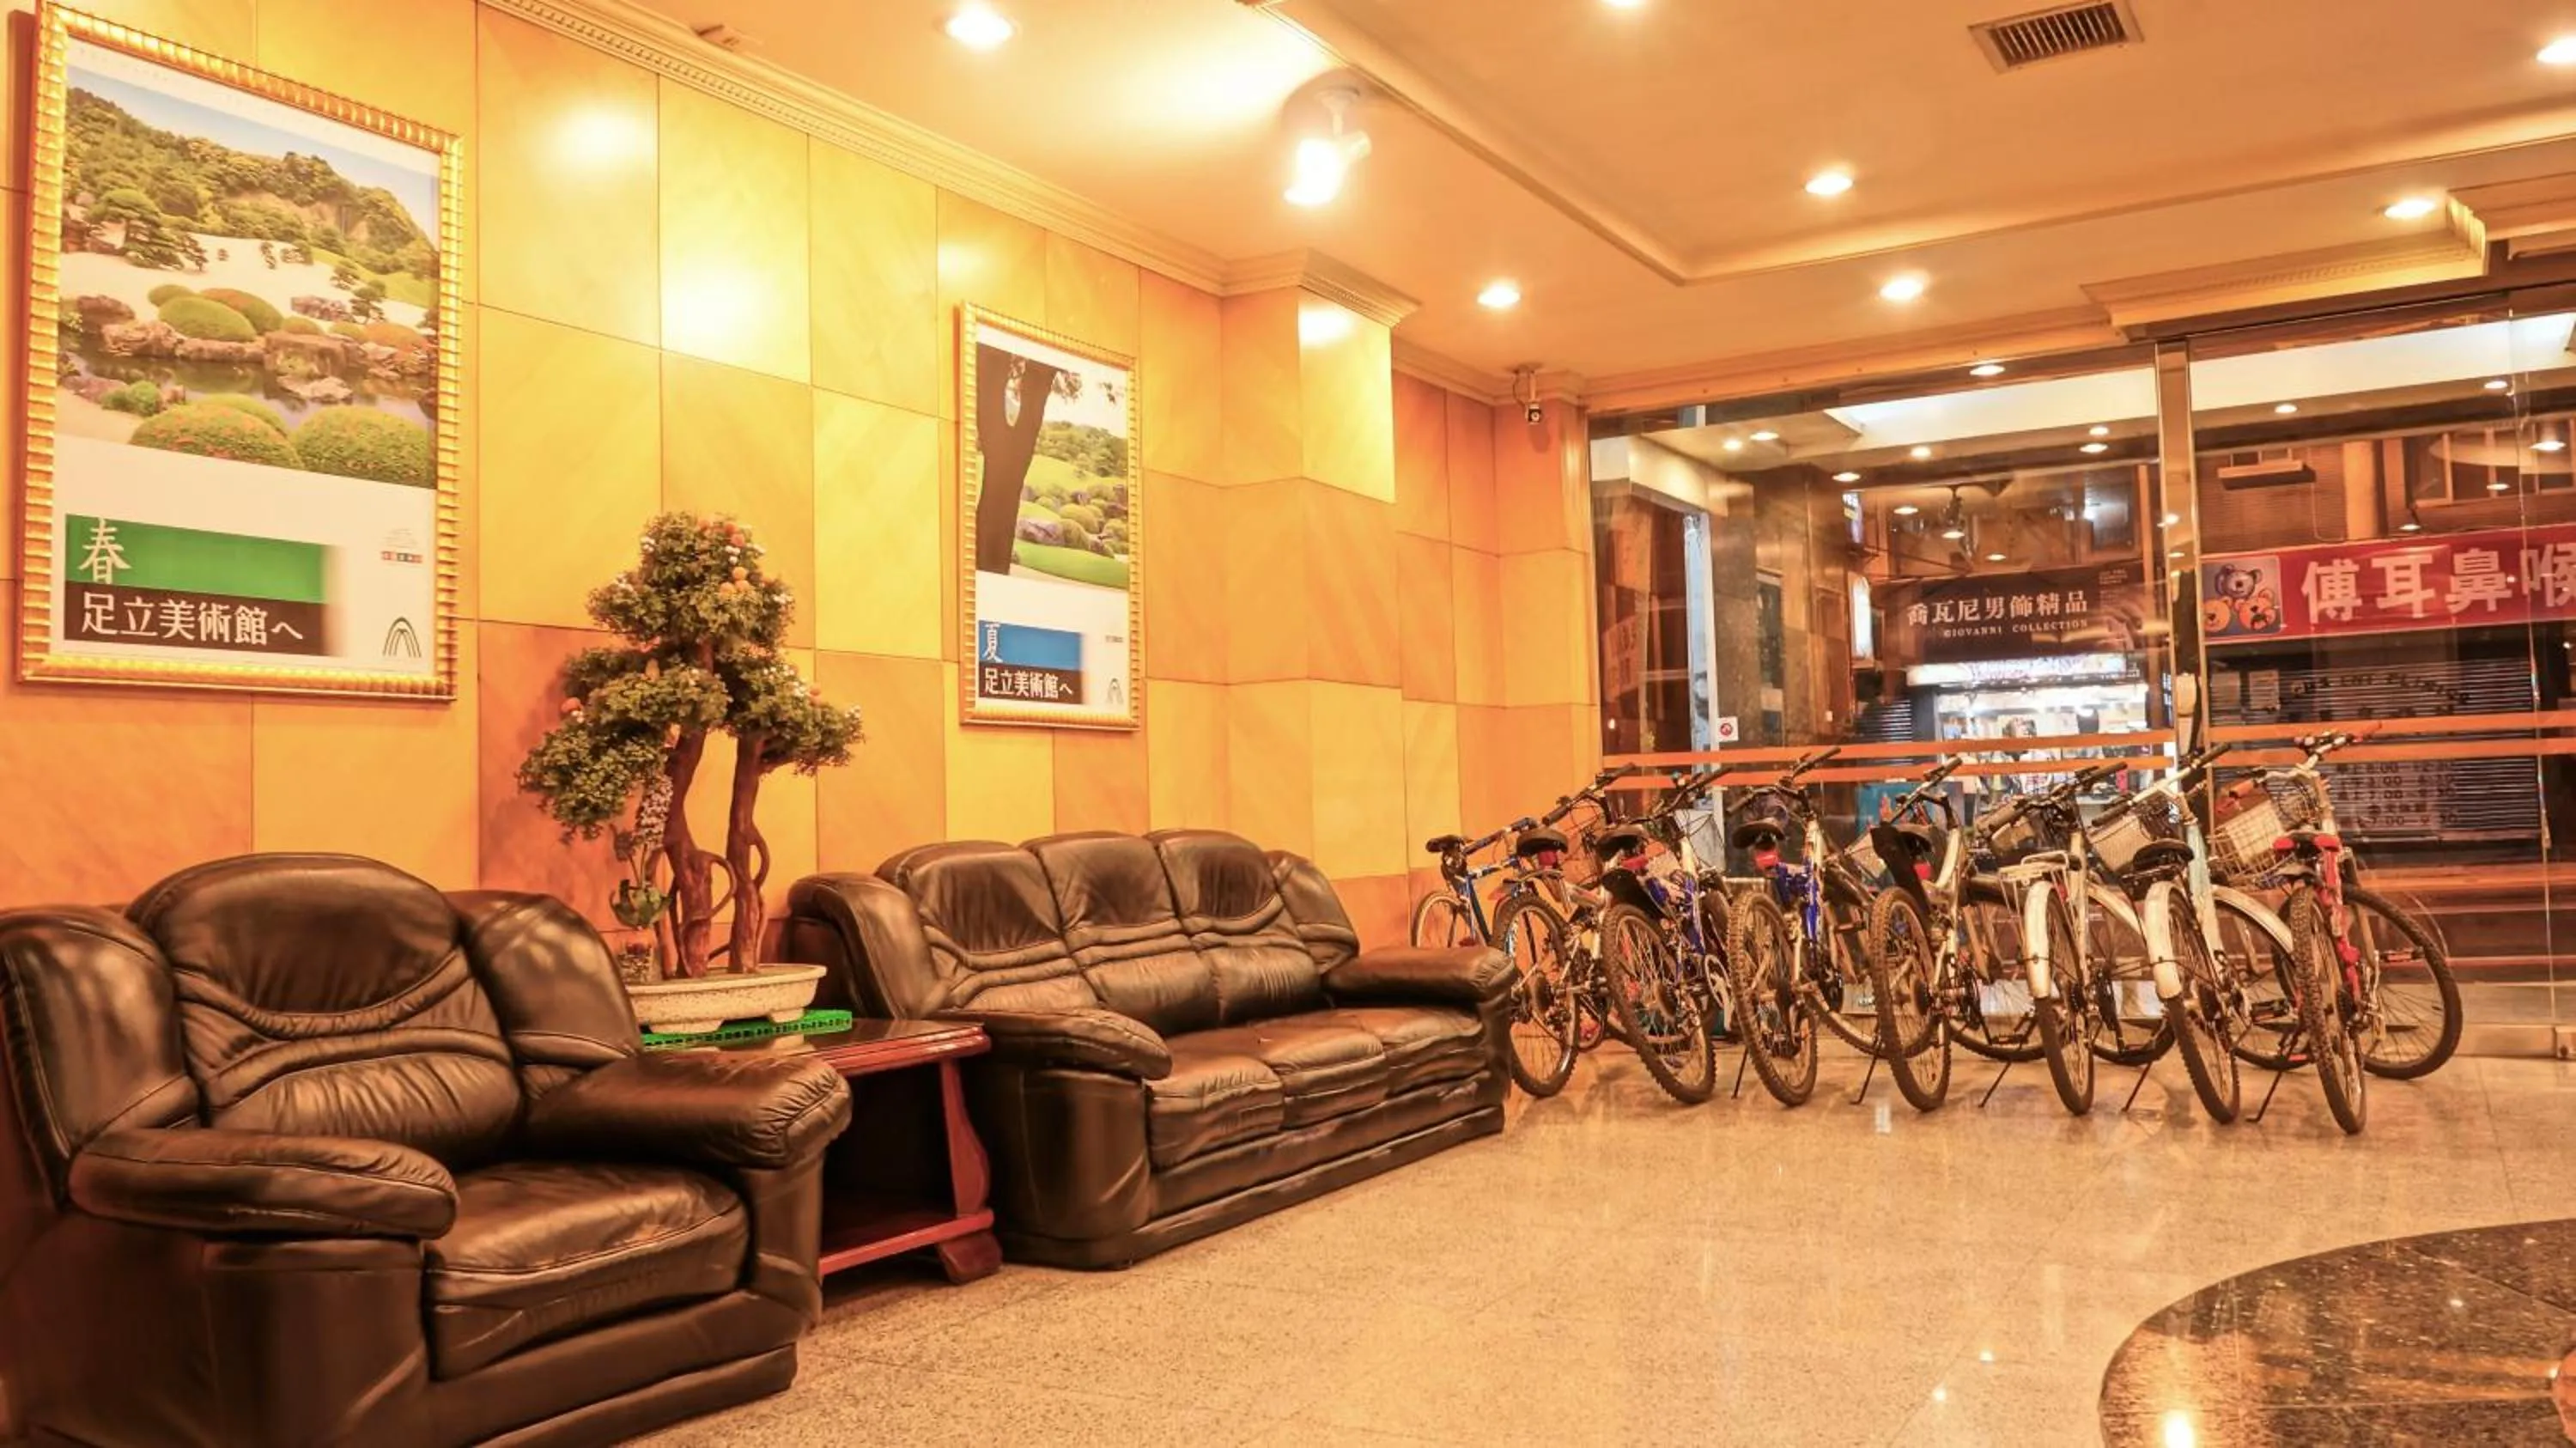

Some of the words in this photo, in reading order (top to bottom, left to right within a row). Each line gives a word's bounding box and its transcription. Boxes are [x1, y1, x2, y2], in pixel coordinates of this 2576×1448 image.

[78, 518, 131, 585] 春
[82, 592, 303, 646] 足立美術館へ
[1944, 628, 2002, 638] GIOVANNI
[2012, 619, 2088, 633] COLLECTION
[982, 622, 1003, 663] 夏
[984, 667, 1072, 698] 足立美術館へ
